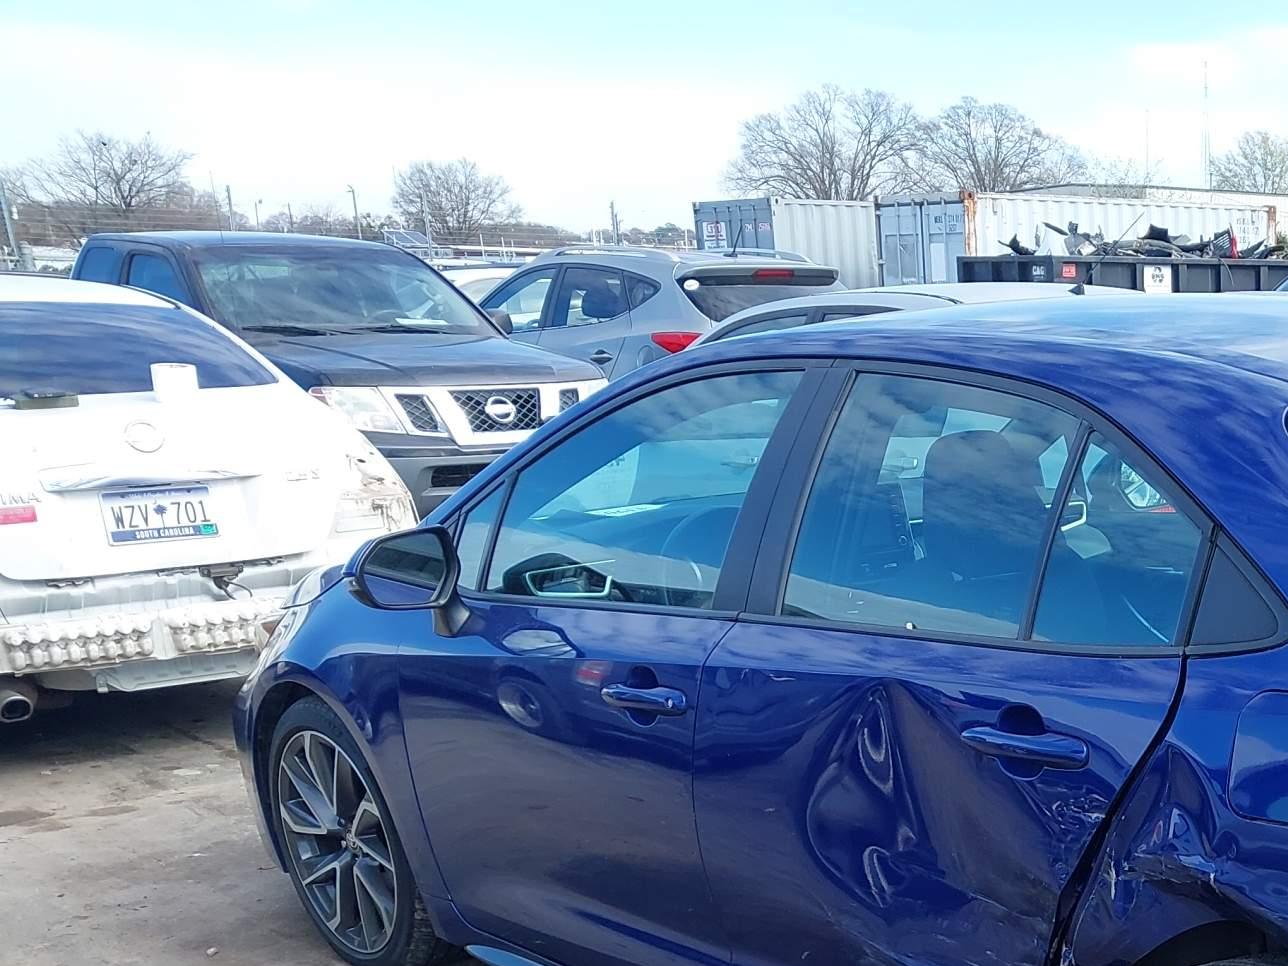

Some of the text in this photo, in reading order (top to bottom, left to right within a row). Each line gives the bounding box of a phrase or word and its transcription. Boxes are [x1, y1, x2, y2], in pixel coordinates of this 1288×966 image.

[111, 500, 211, 529] WZV 701
[135, 528, 160, 540] SOUTH
[160, 526, 195, 538] CAROLINA
